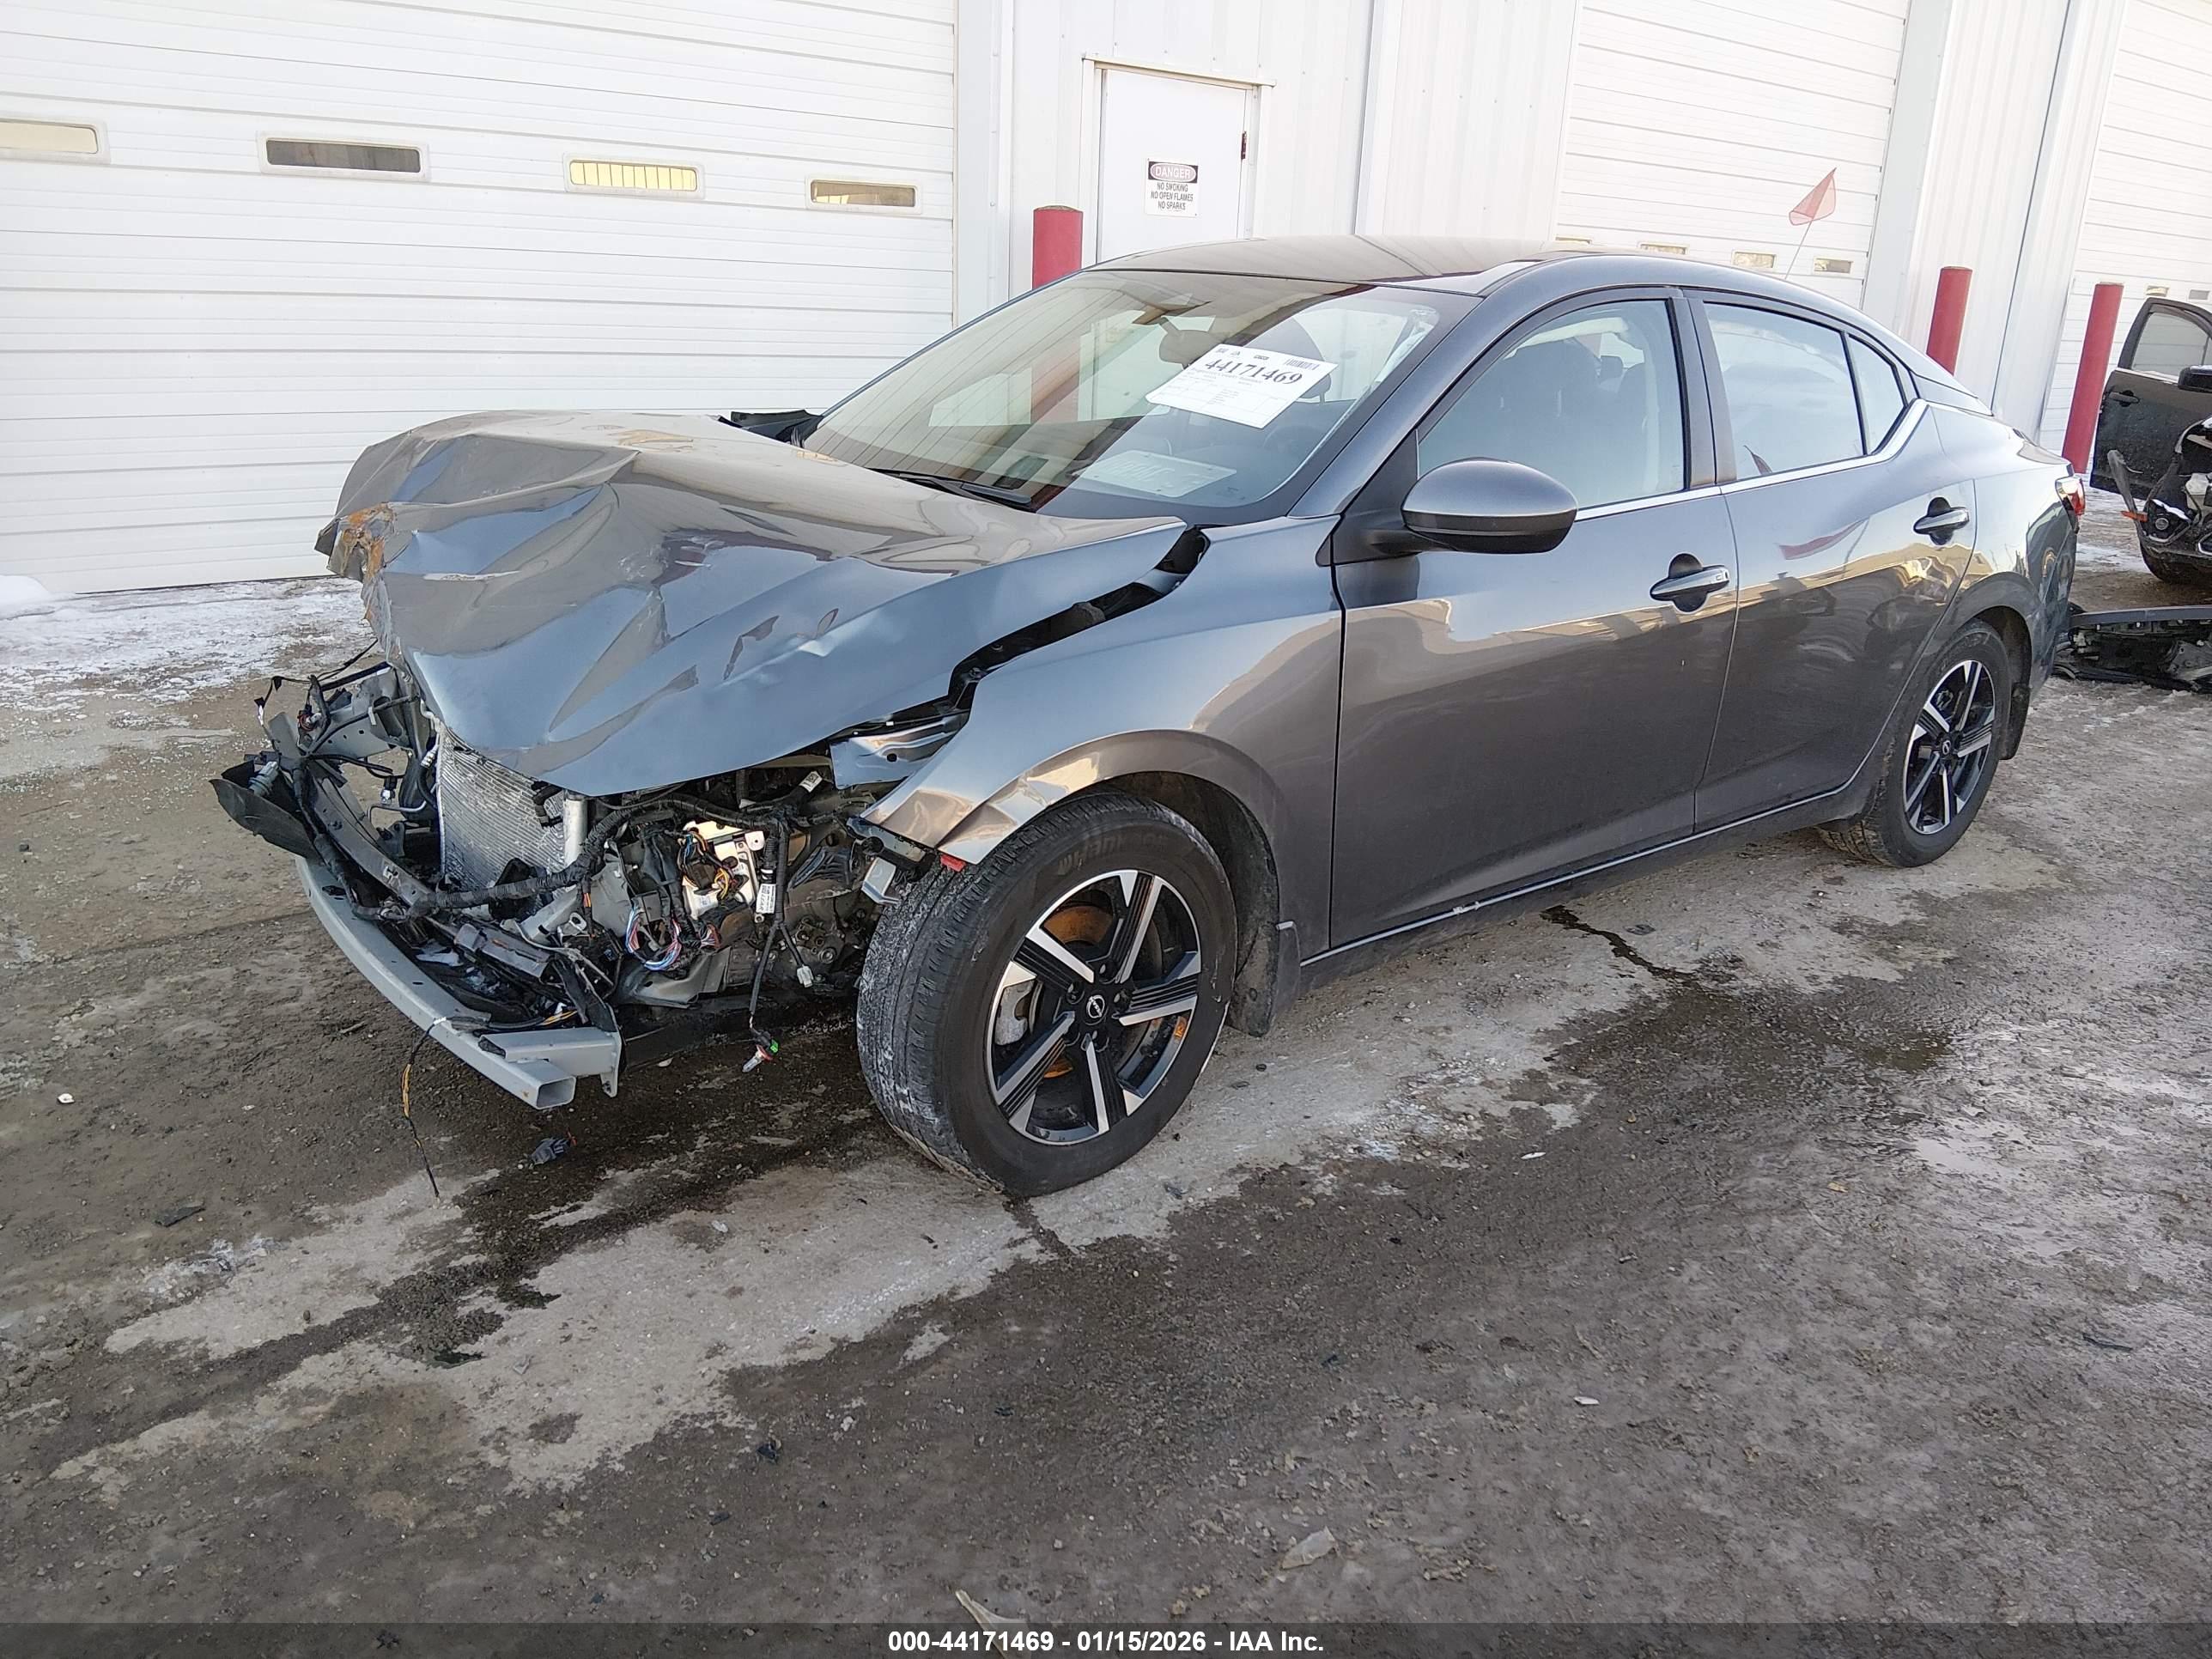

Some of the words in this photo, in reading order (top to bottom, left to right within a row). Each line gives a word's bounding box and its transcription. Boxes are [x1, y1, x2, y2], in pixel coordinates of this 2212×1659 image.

[1155, 167, 1190, 179] DANGER
[1158, 182, 1164, 191] NO
[1165, 183, 1188, 192] SMOKING
[1151, 191, 1158, 199] NO
[1159, 191, 1173, 200] OPEN
[1174, 192, 1194, 202] FLAMES
[1166, 201, 1186, 210] SPARKS
[1205, 358, 1303, 385] 44171469
